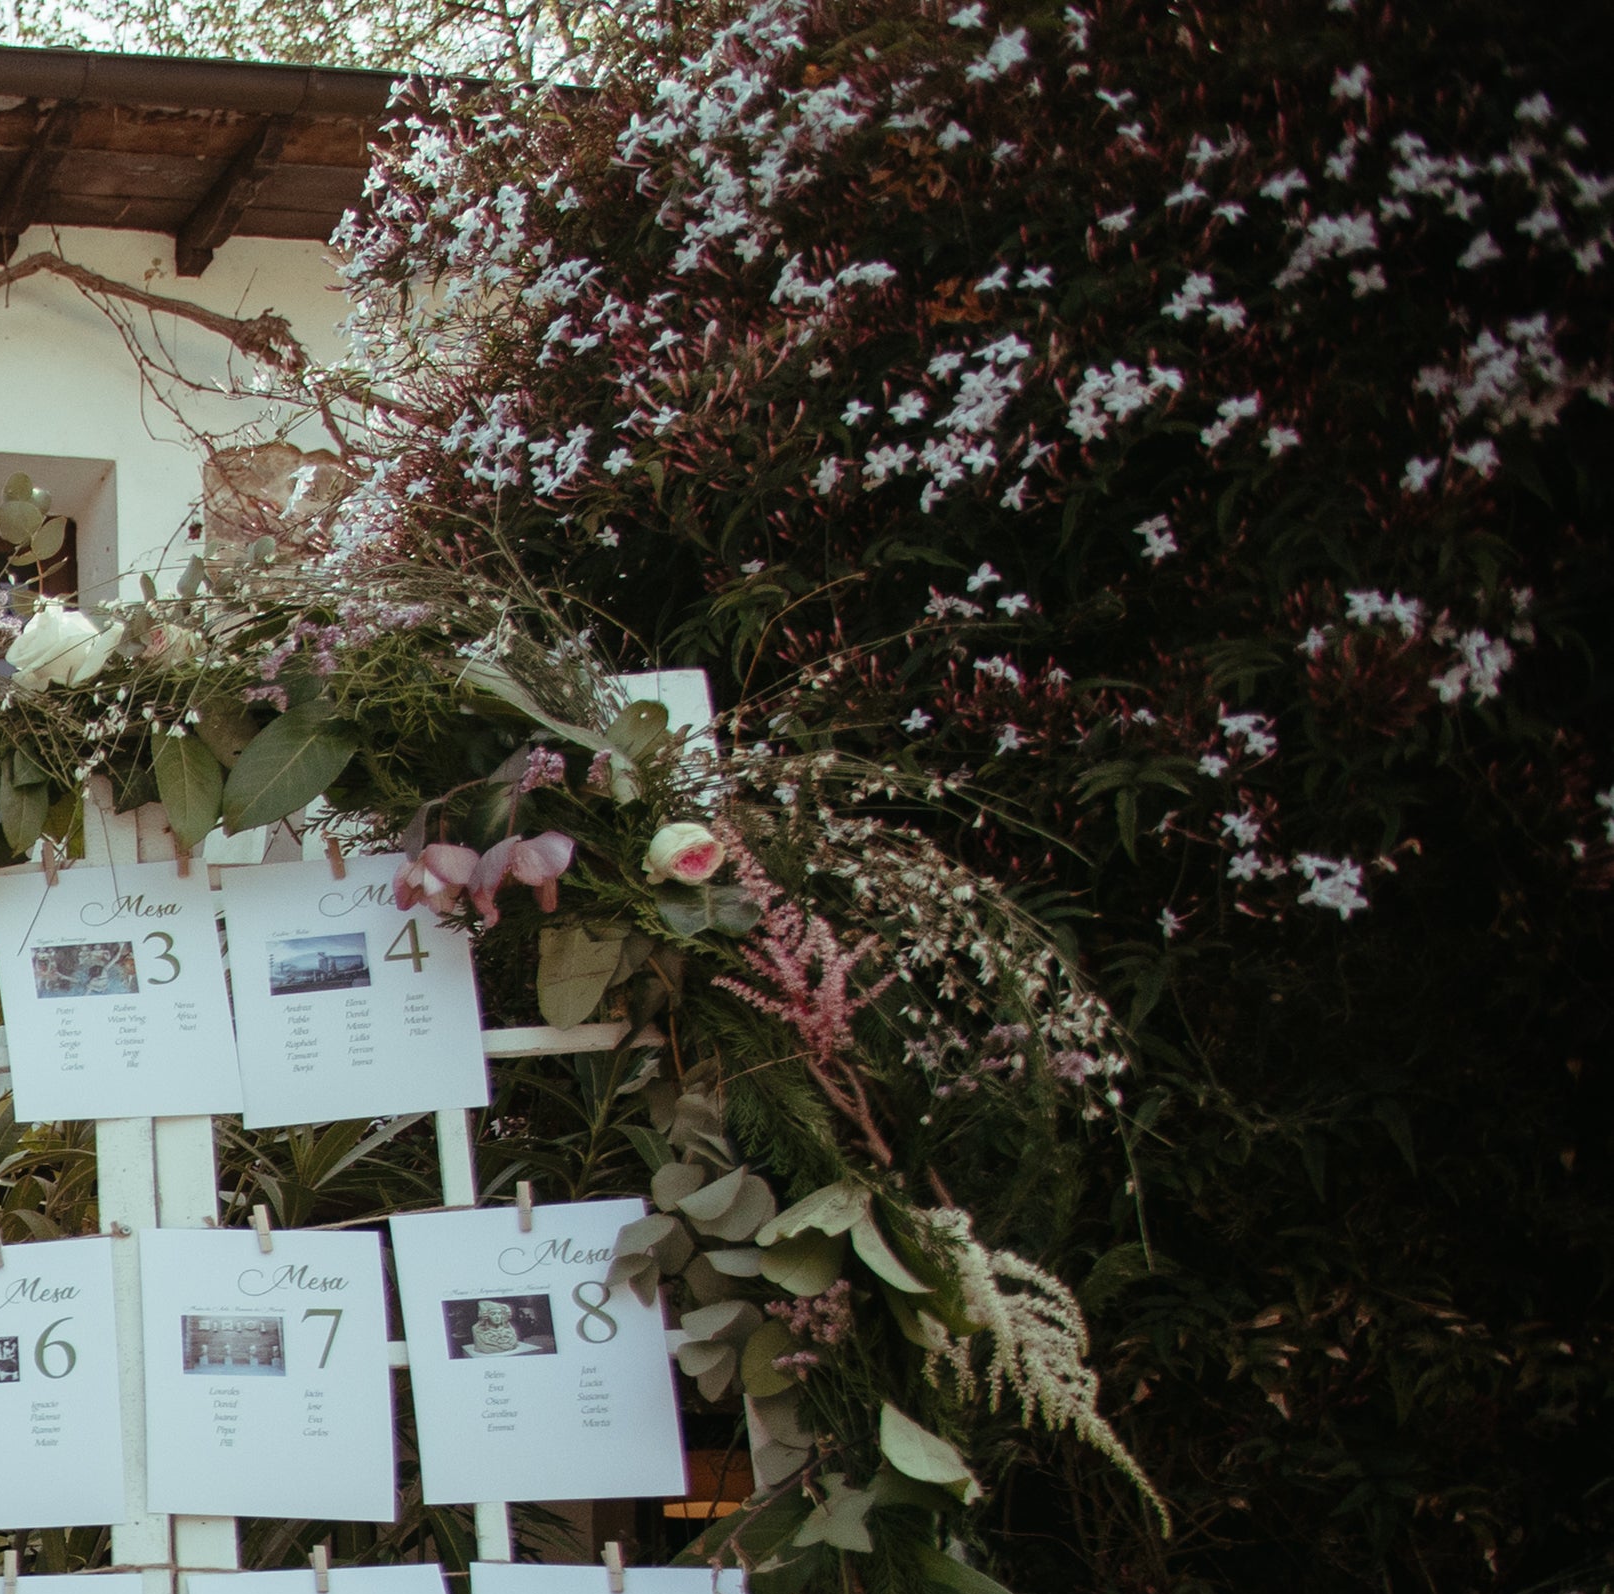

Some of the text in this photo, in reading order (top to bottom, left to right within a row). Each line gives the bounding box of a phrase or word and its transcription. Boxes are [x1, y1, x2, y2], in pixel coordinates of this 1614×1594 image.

[80, 894, 182, 927] Mesa
[384, 919, 430, 973] 4
[142, 931, 181, 985] 3
[345, 999, 367, 1007] Elena
[346, 1009, 370, 1018] David
[288, 1016, 311, 1024] Pablo
[409, 1028, 431, 1036] Pilar
[59, 1041, 82, 1050] Sergio
[122, 1049, 140, 1059] Jorge
[287, 1051, 320, 1060] Tamara
[292, 1064, 315, 1073] Borja
[498, 1238, 614, 1276] Mesa
[238, 1265, 348, 1296] Mesa
[572, 1280, 618, 1344] 8
[301, 1309, 343, 1369] 7
[34, 1317, 76, 1379] 6
[576, 1393, 610, 1401] Susana
[482, 1410, 519, 1418] Carolina
[581, 1405, 609, 1414] Carlos
[303, 1428, 330, 1436] Carlos
